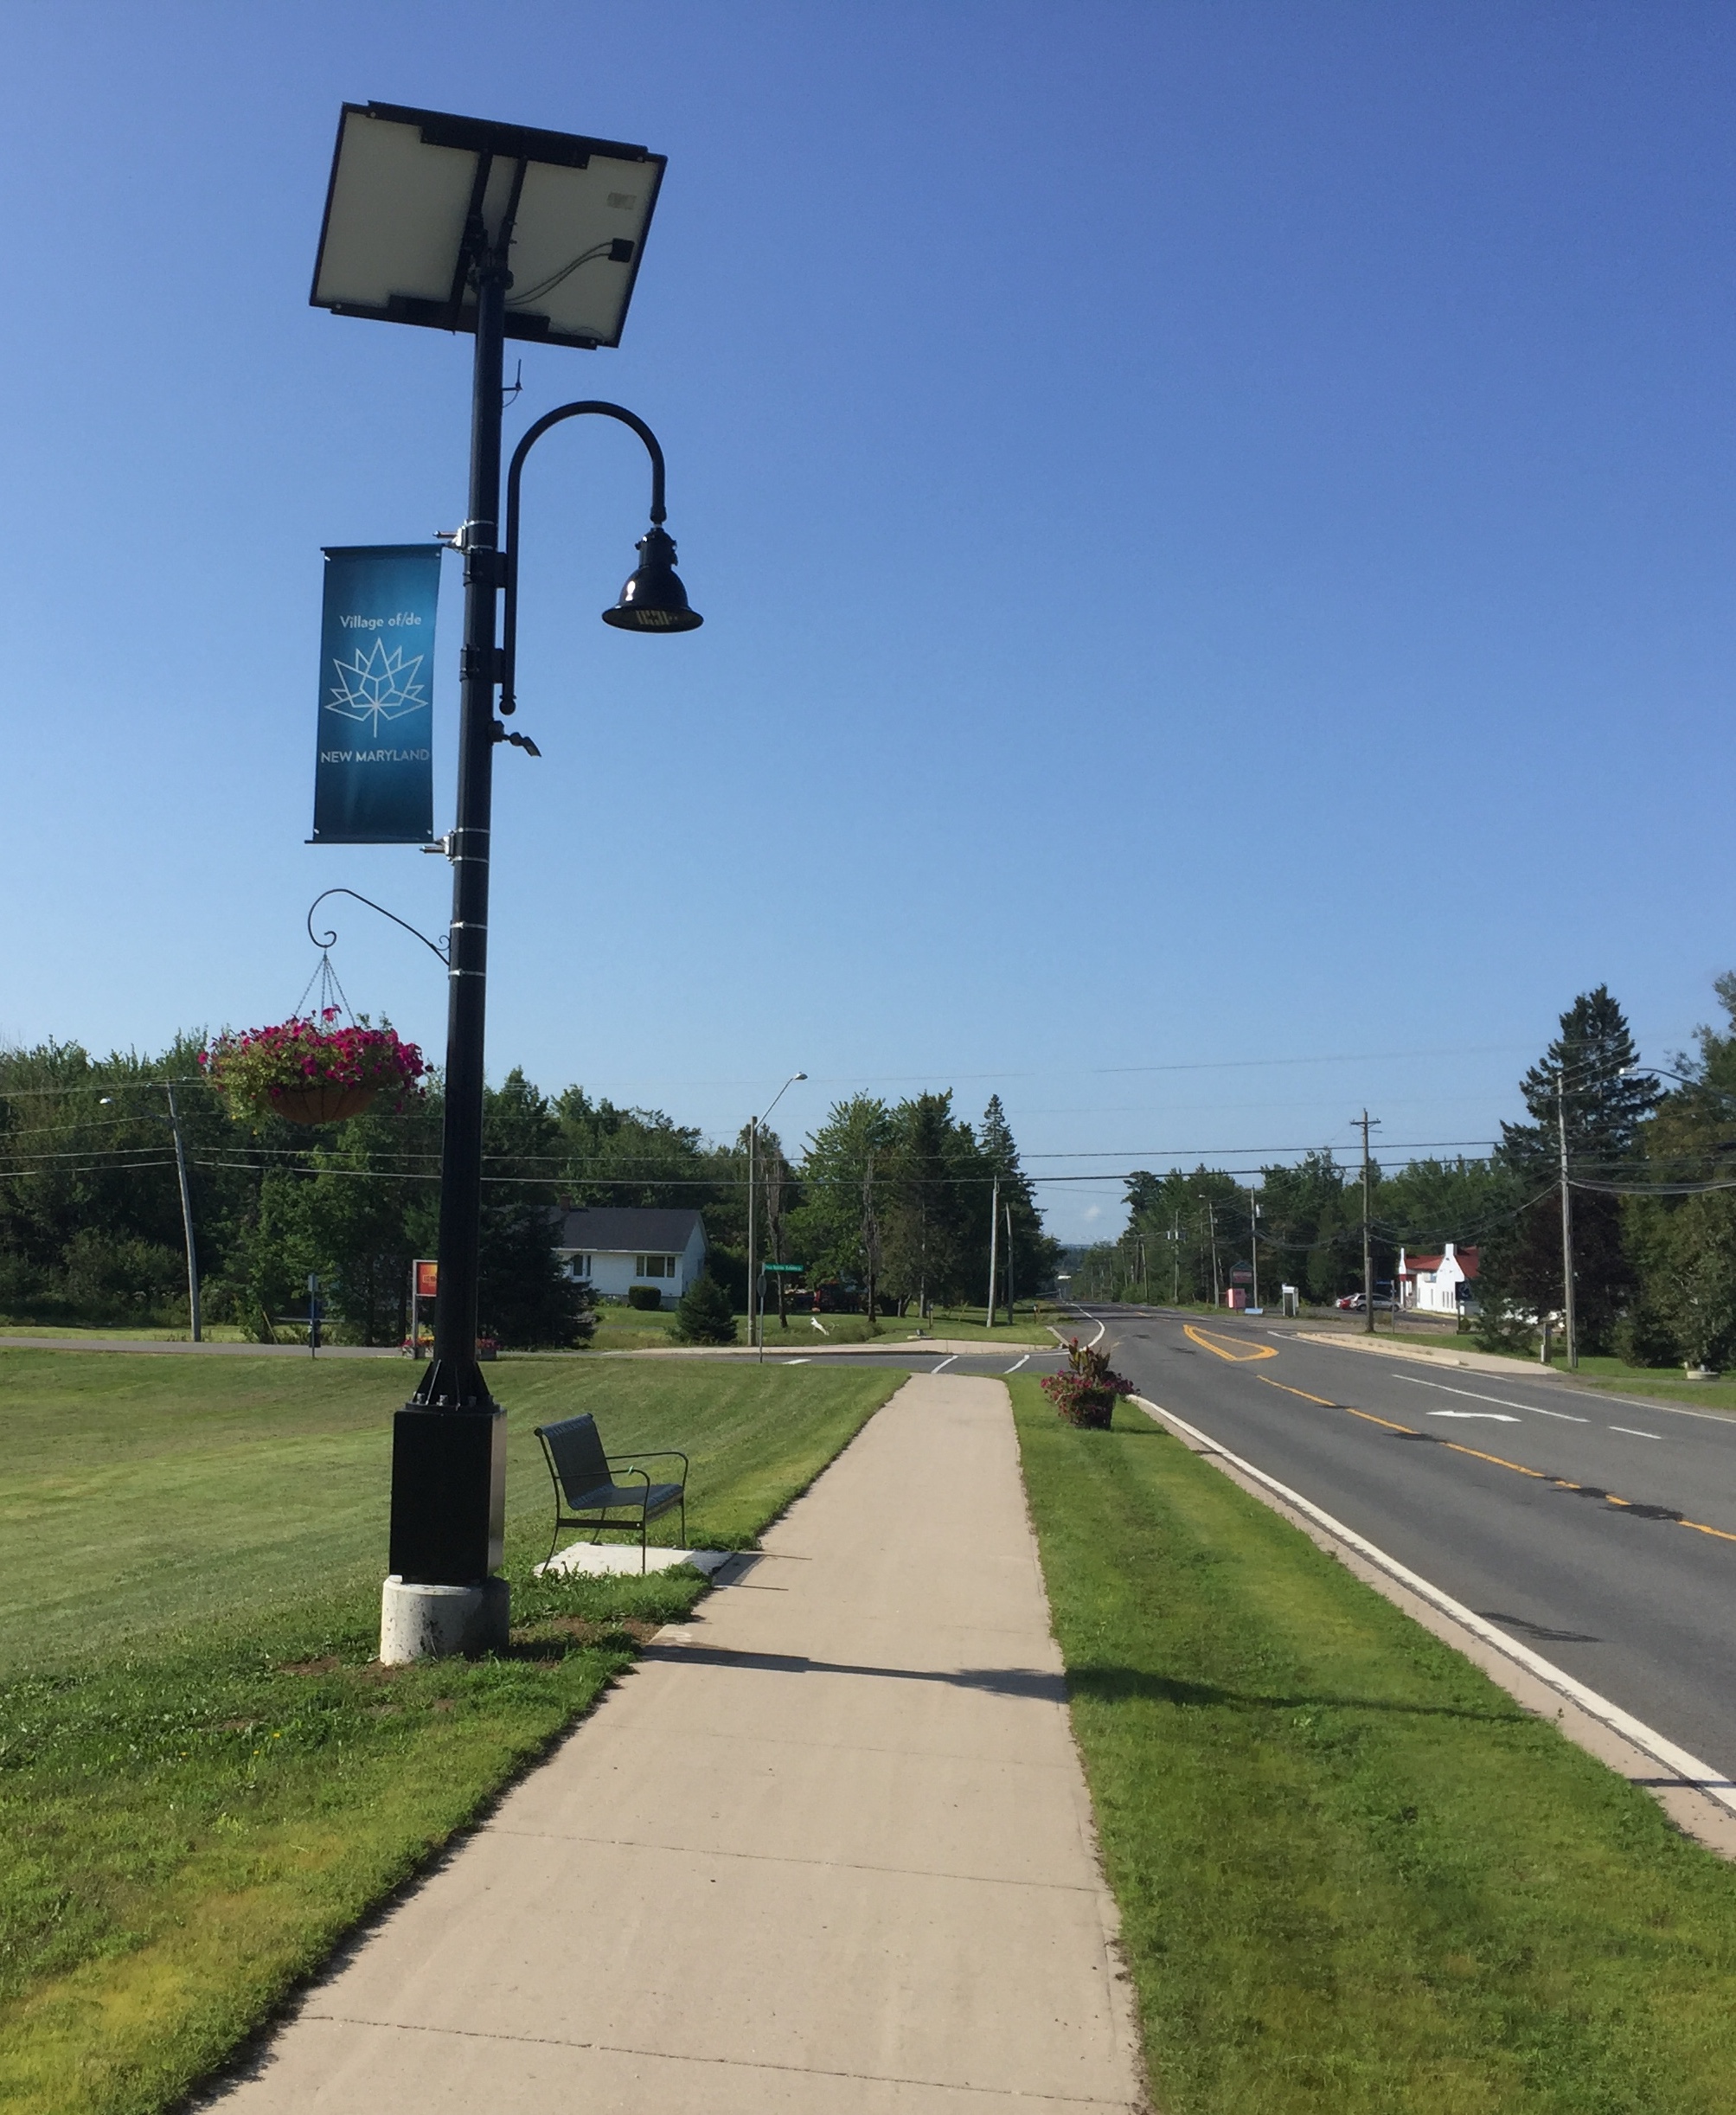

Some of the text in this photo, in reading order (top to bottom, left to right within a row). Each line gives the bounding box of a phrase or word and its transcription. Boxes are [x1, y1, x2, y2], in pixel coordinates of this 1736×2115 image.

[339, 612, 422, 631] Village of/de
[321, 748, 431, 763] NEW MARYLAND
